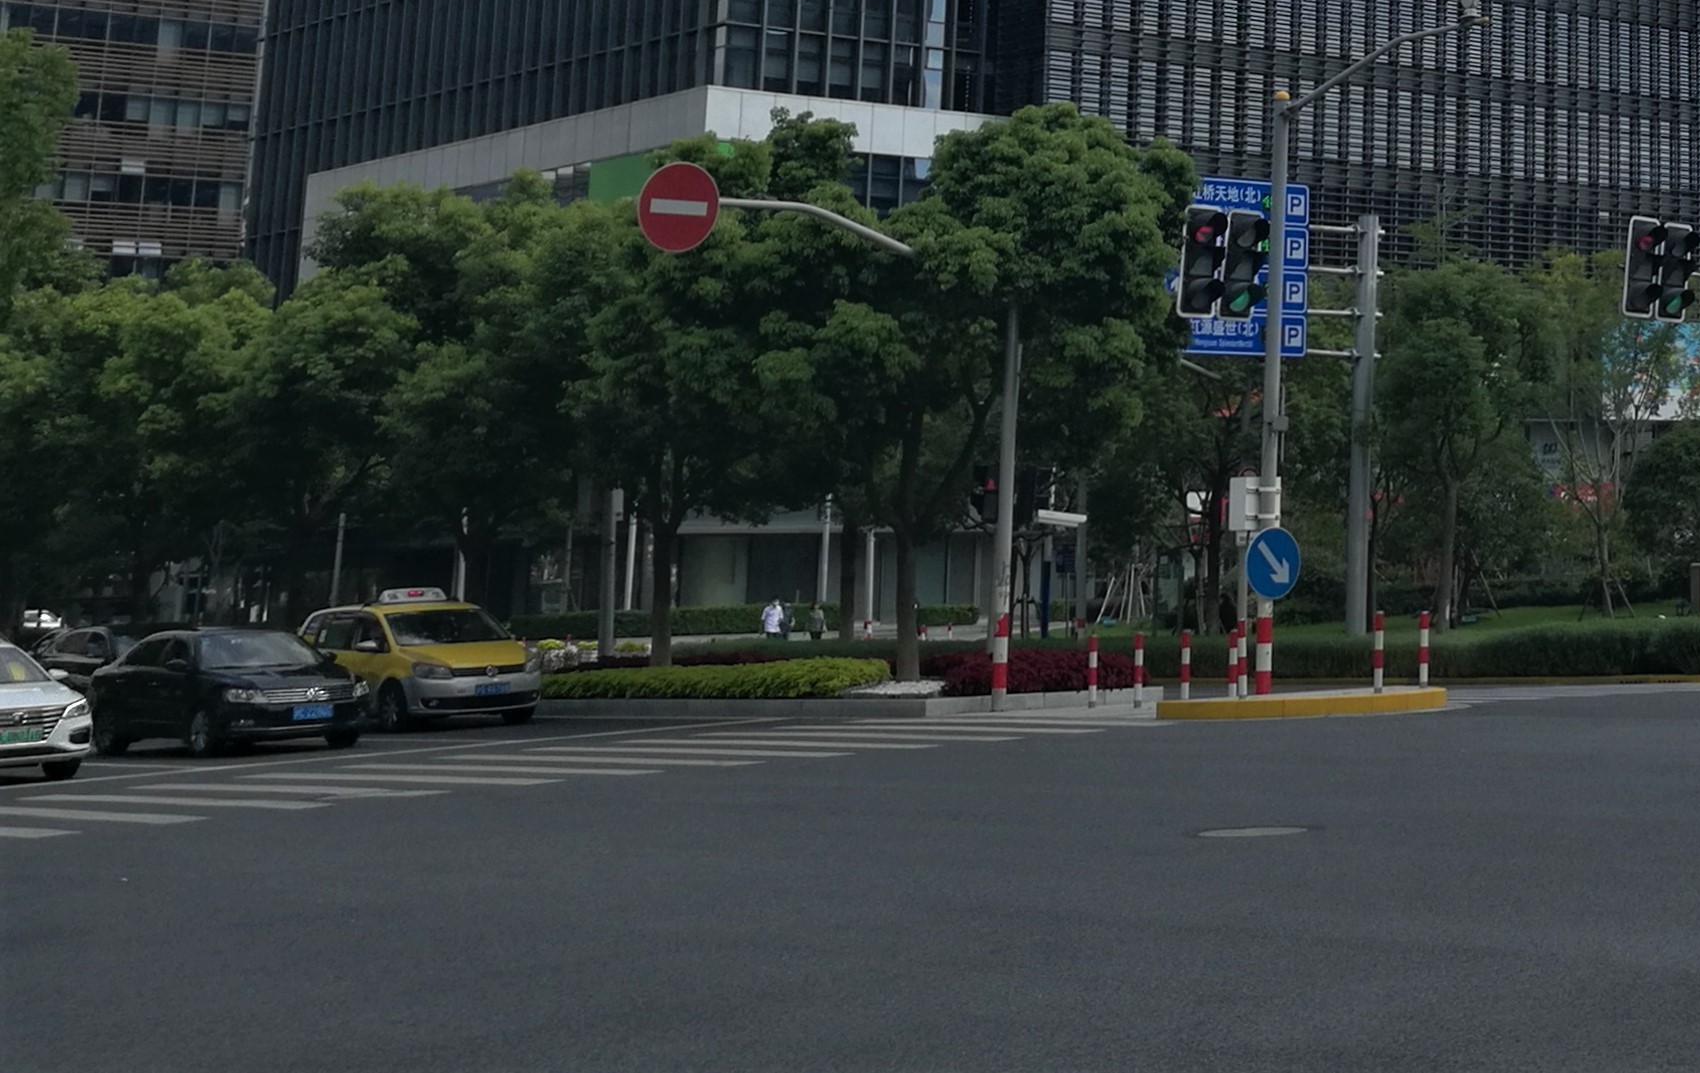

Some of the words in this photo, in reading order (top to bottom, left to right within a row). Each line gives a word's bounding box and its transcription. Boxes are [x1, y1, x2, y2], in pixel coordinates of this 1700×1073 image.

[1290, 196, 1302, 213] P
[1290, 240, 1301, 256] P
[1289, 284, 1300, 300] P
[1288, 327, 1299, 344] P
